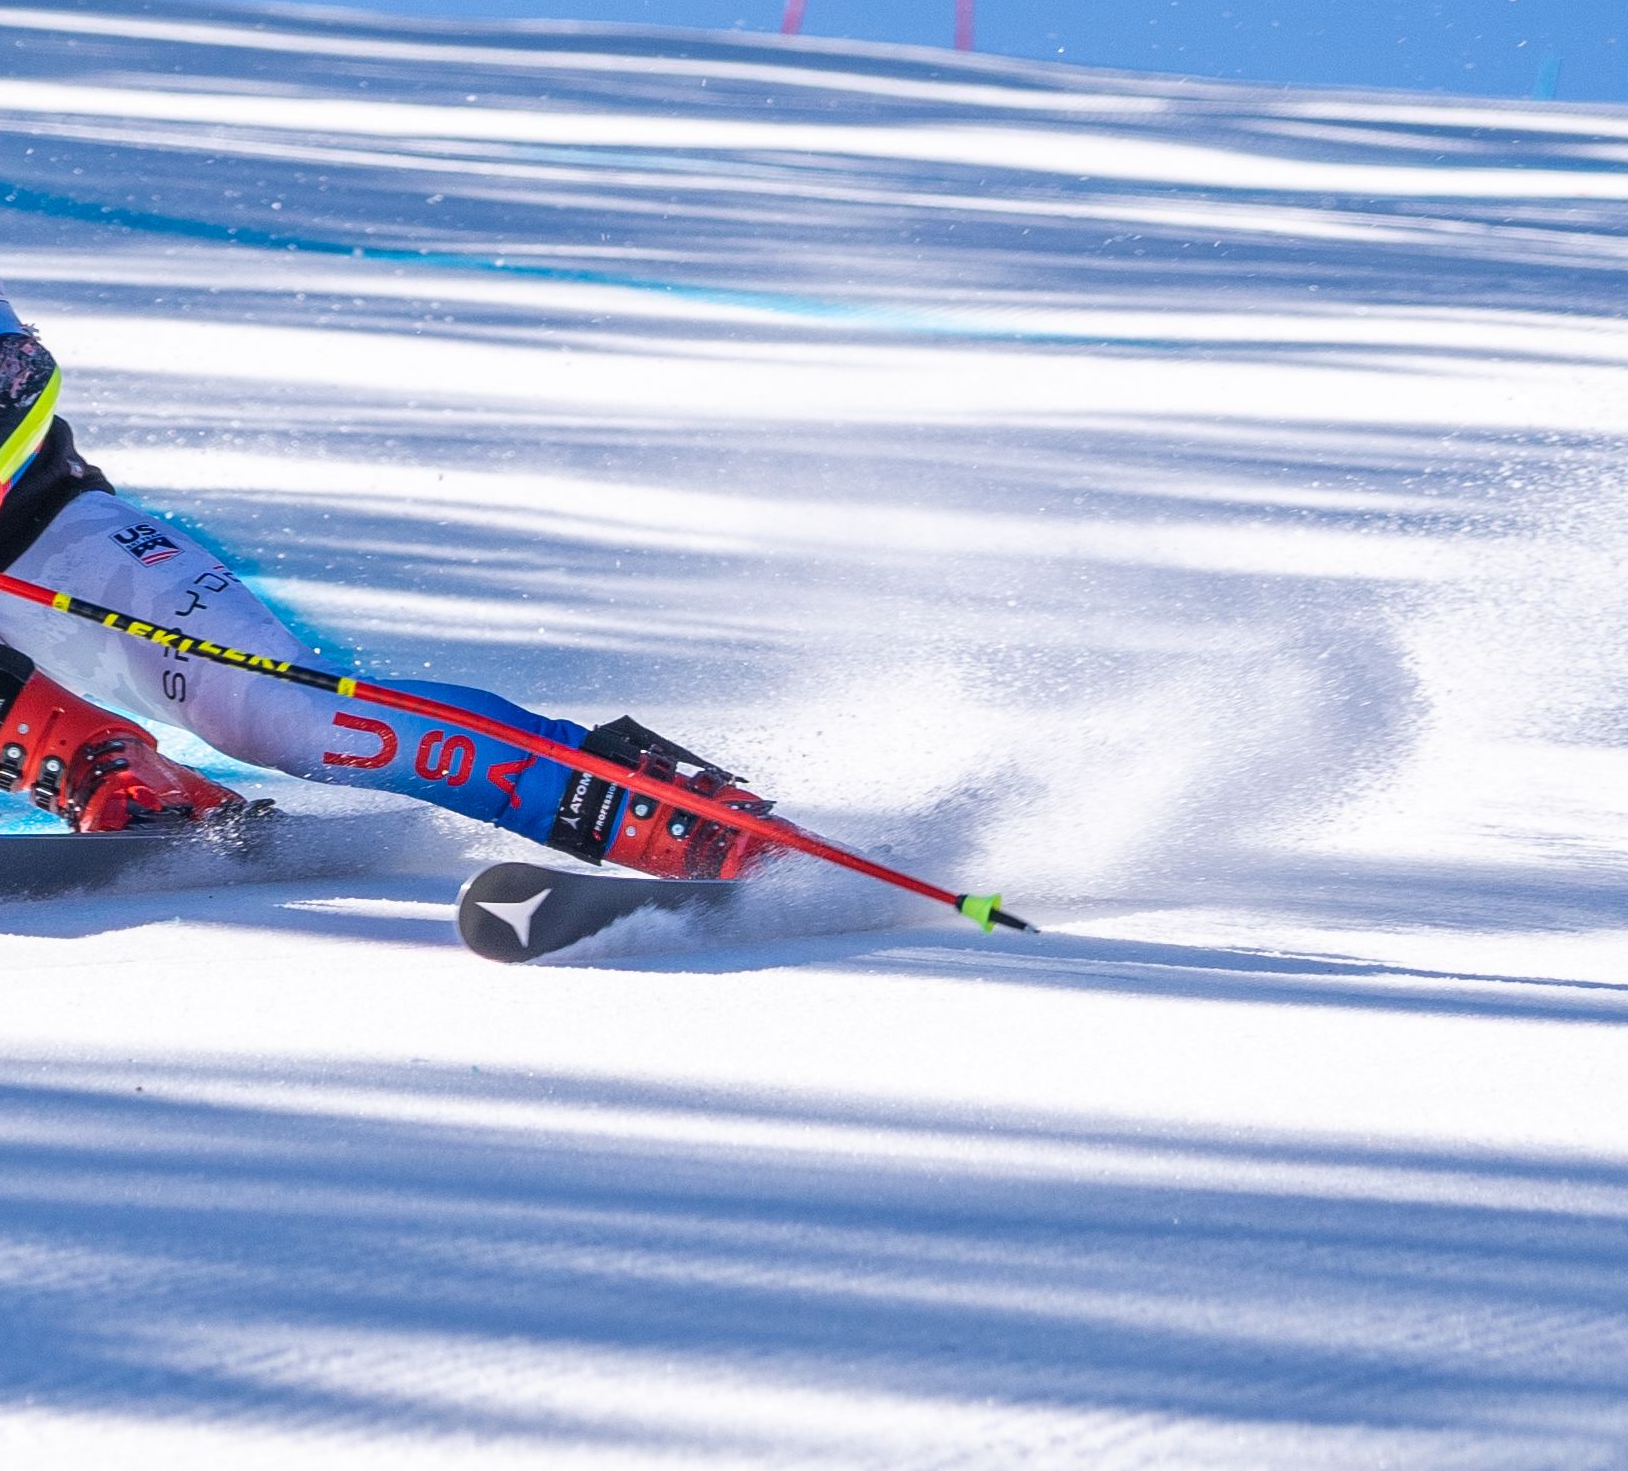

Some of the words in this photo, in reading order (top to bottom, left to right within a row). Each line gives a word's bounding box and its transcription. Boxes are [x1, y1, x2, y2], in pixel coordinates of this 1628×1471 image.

[113, 524, 157, 545] US
[102, 612, 195, 653] LEKI
[322, 711, 538, 811] USA
[569, 772, 593, 814] ATOM
